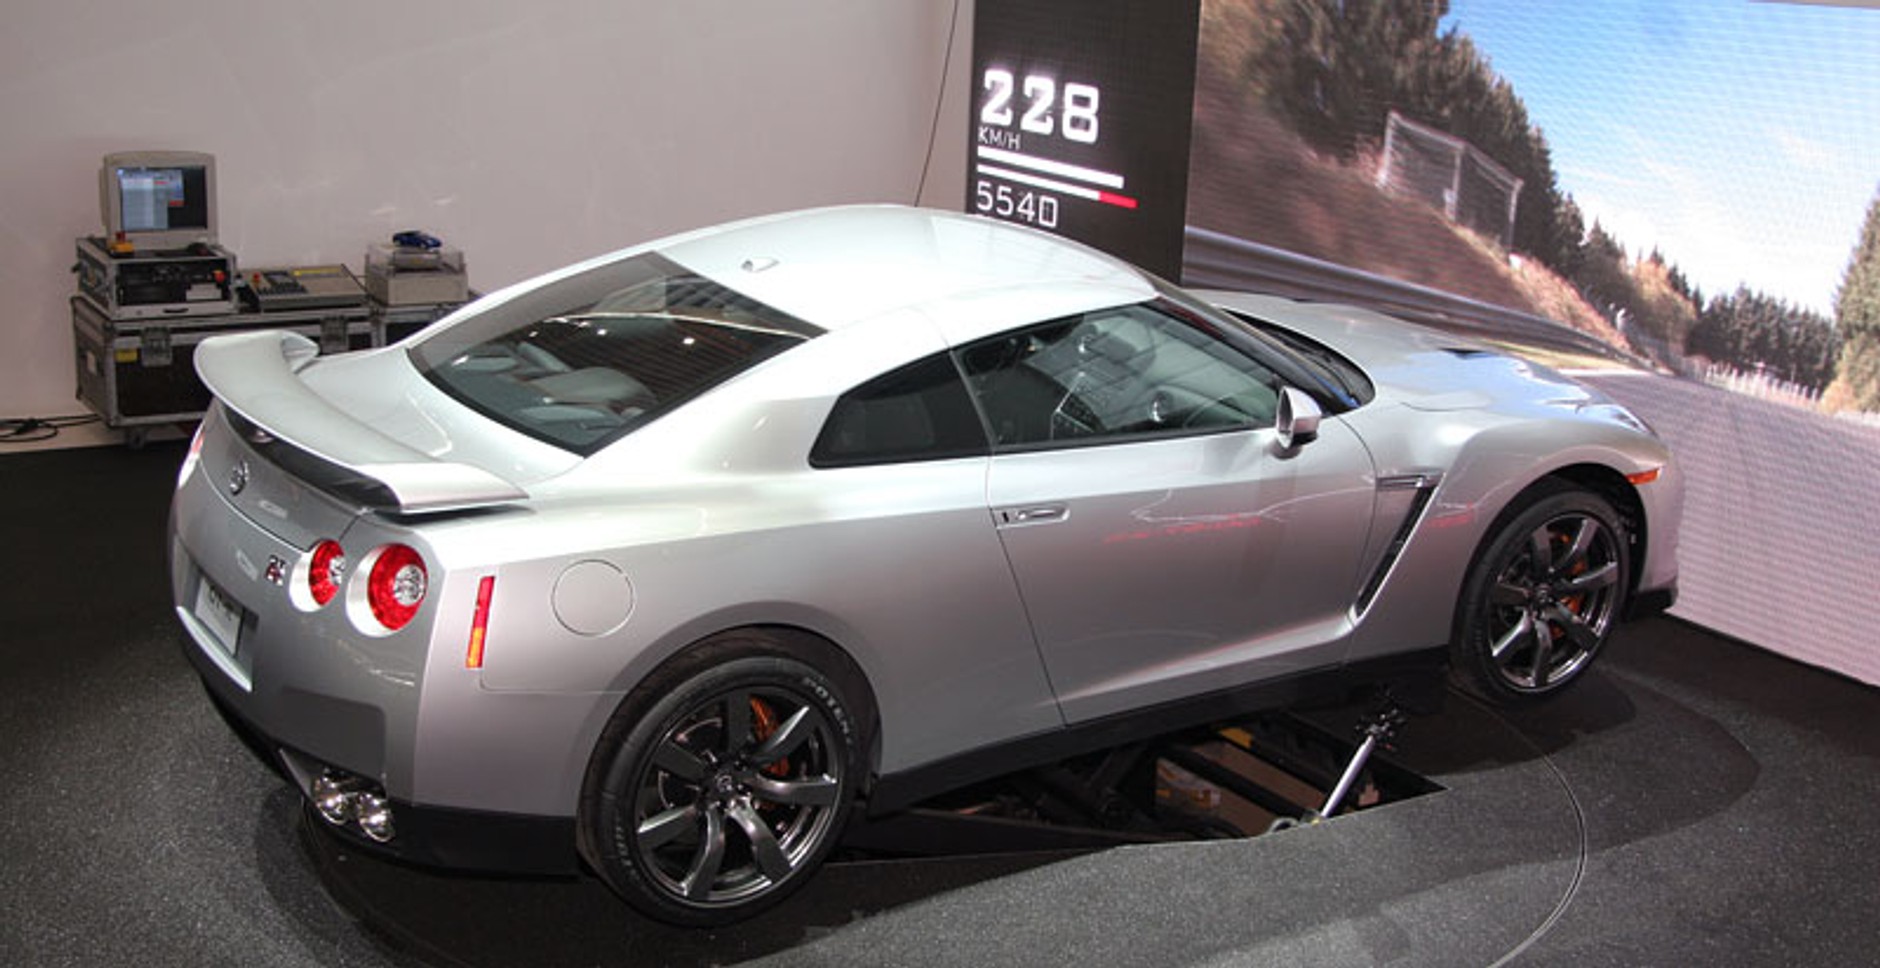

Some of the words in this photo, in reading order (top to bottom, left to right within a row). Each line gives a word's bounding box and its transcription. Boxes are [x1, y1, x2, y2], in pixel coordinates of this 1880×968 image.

[981, 69, 1099, 144] 228
[978, 127, 1021, 150] KM/H
[977, 181, 1058, 228] 5540
